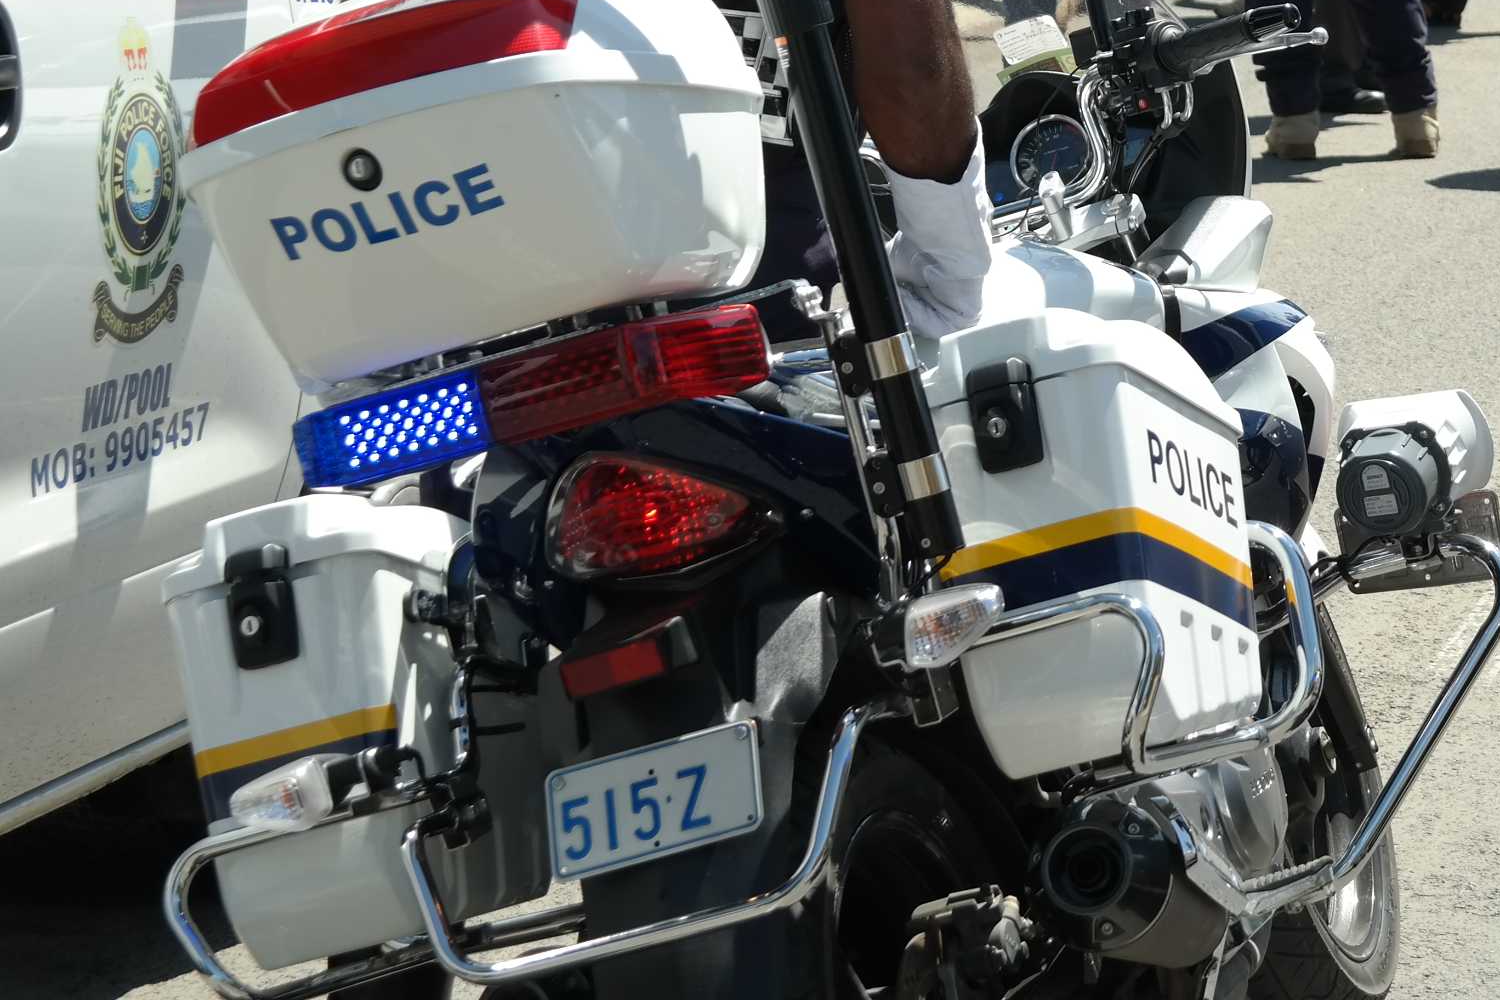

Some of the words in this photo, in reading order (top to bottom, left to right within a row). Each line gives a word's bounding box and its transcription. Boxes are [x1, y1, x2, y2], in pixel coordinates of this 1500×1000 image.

[120, 100, 156, 142] POLICE
[156, 118, 172, 199] FORCE
[269, 162, 505, 261] POLICE
[82, 362, 172, 433] WD/POOL
[31, 442, 96, 498] MOB:
[105, 401, 210, 473] 9905457
[1146, 429, 1239, 529] POLICE
